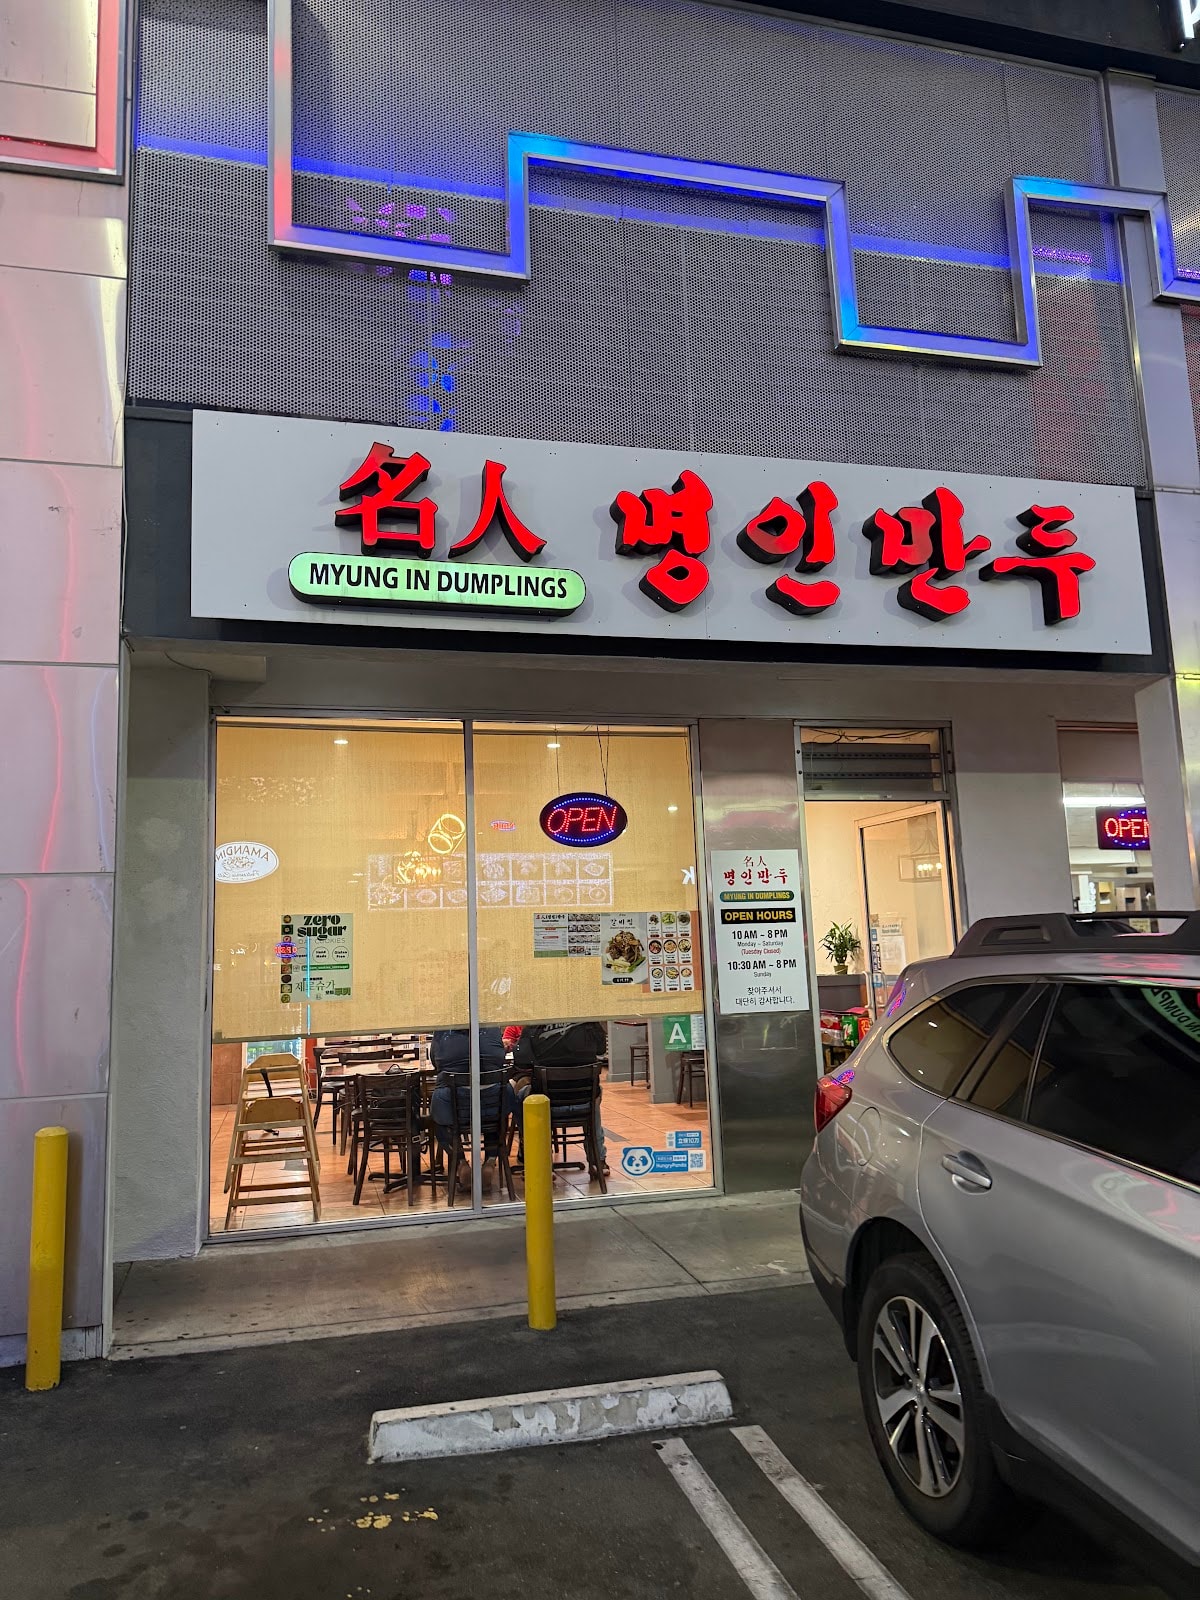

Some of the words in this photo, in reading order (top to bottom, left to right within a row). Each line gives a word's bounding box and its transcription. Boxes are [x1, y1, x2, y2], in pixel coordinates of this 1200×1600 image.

[335, 441, 548, 560] 名人
[611, 470, 1096, 622] 명인만두
[309, 562, 399, 589] MYUNG
[406, 568, 431, 591] IN
[436, 571, 568, 599] DUMPLINGS
[546, 806, 617, 834] OPEN
[743, 855, 767, 867] 名人
[747, 892, 755, 900] IN
[755, 891, 790, 900] DUMPLINGS
[303, 915, 341, 927] zero
[724, 911, 753, 921] OPEN
[756, 910, 793, 920] HOURS
[297, 925, 347, 941] sugar
[732, 930, 742, 939] 10
[744, 930, 758, 939] AM
[767, 929, 773, 939] 8
[774, 929, 788, 938] PM
[728, 961, 751, 971] 10:30
[752, 960, 766, 970] AM
[776, 960, 782, 969] 8
[783, 959, 797, 968] PM
[668, 1022, 687, 1044] A
